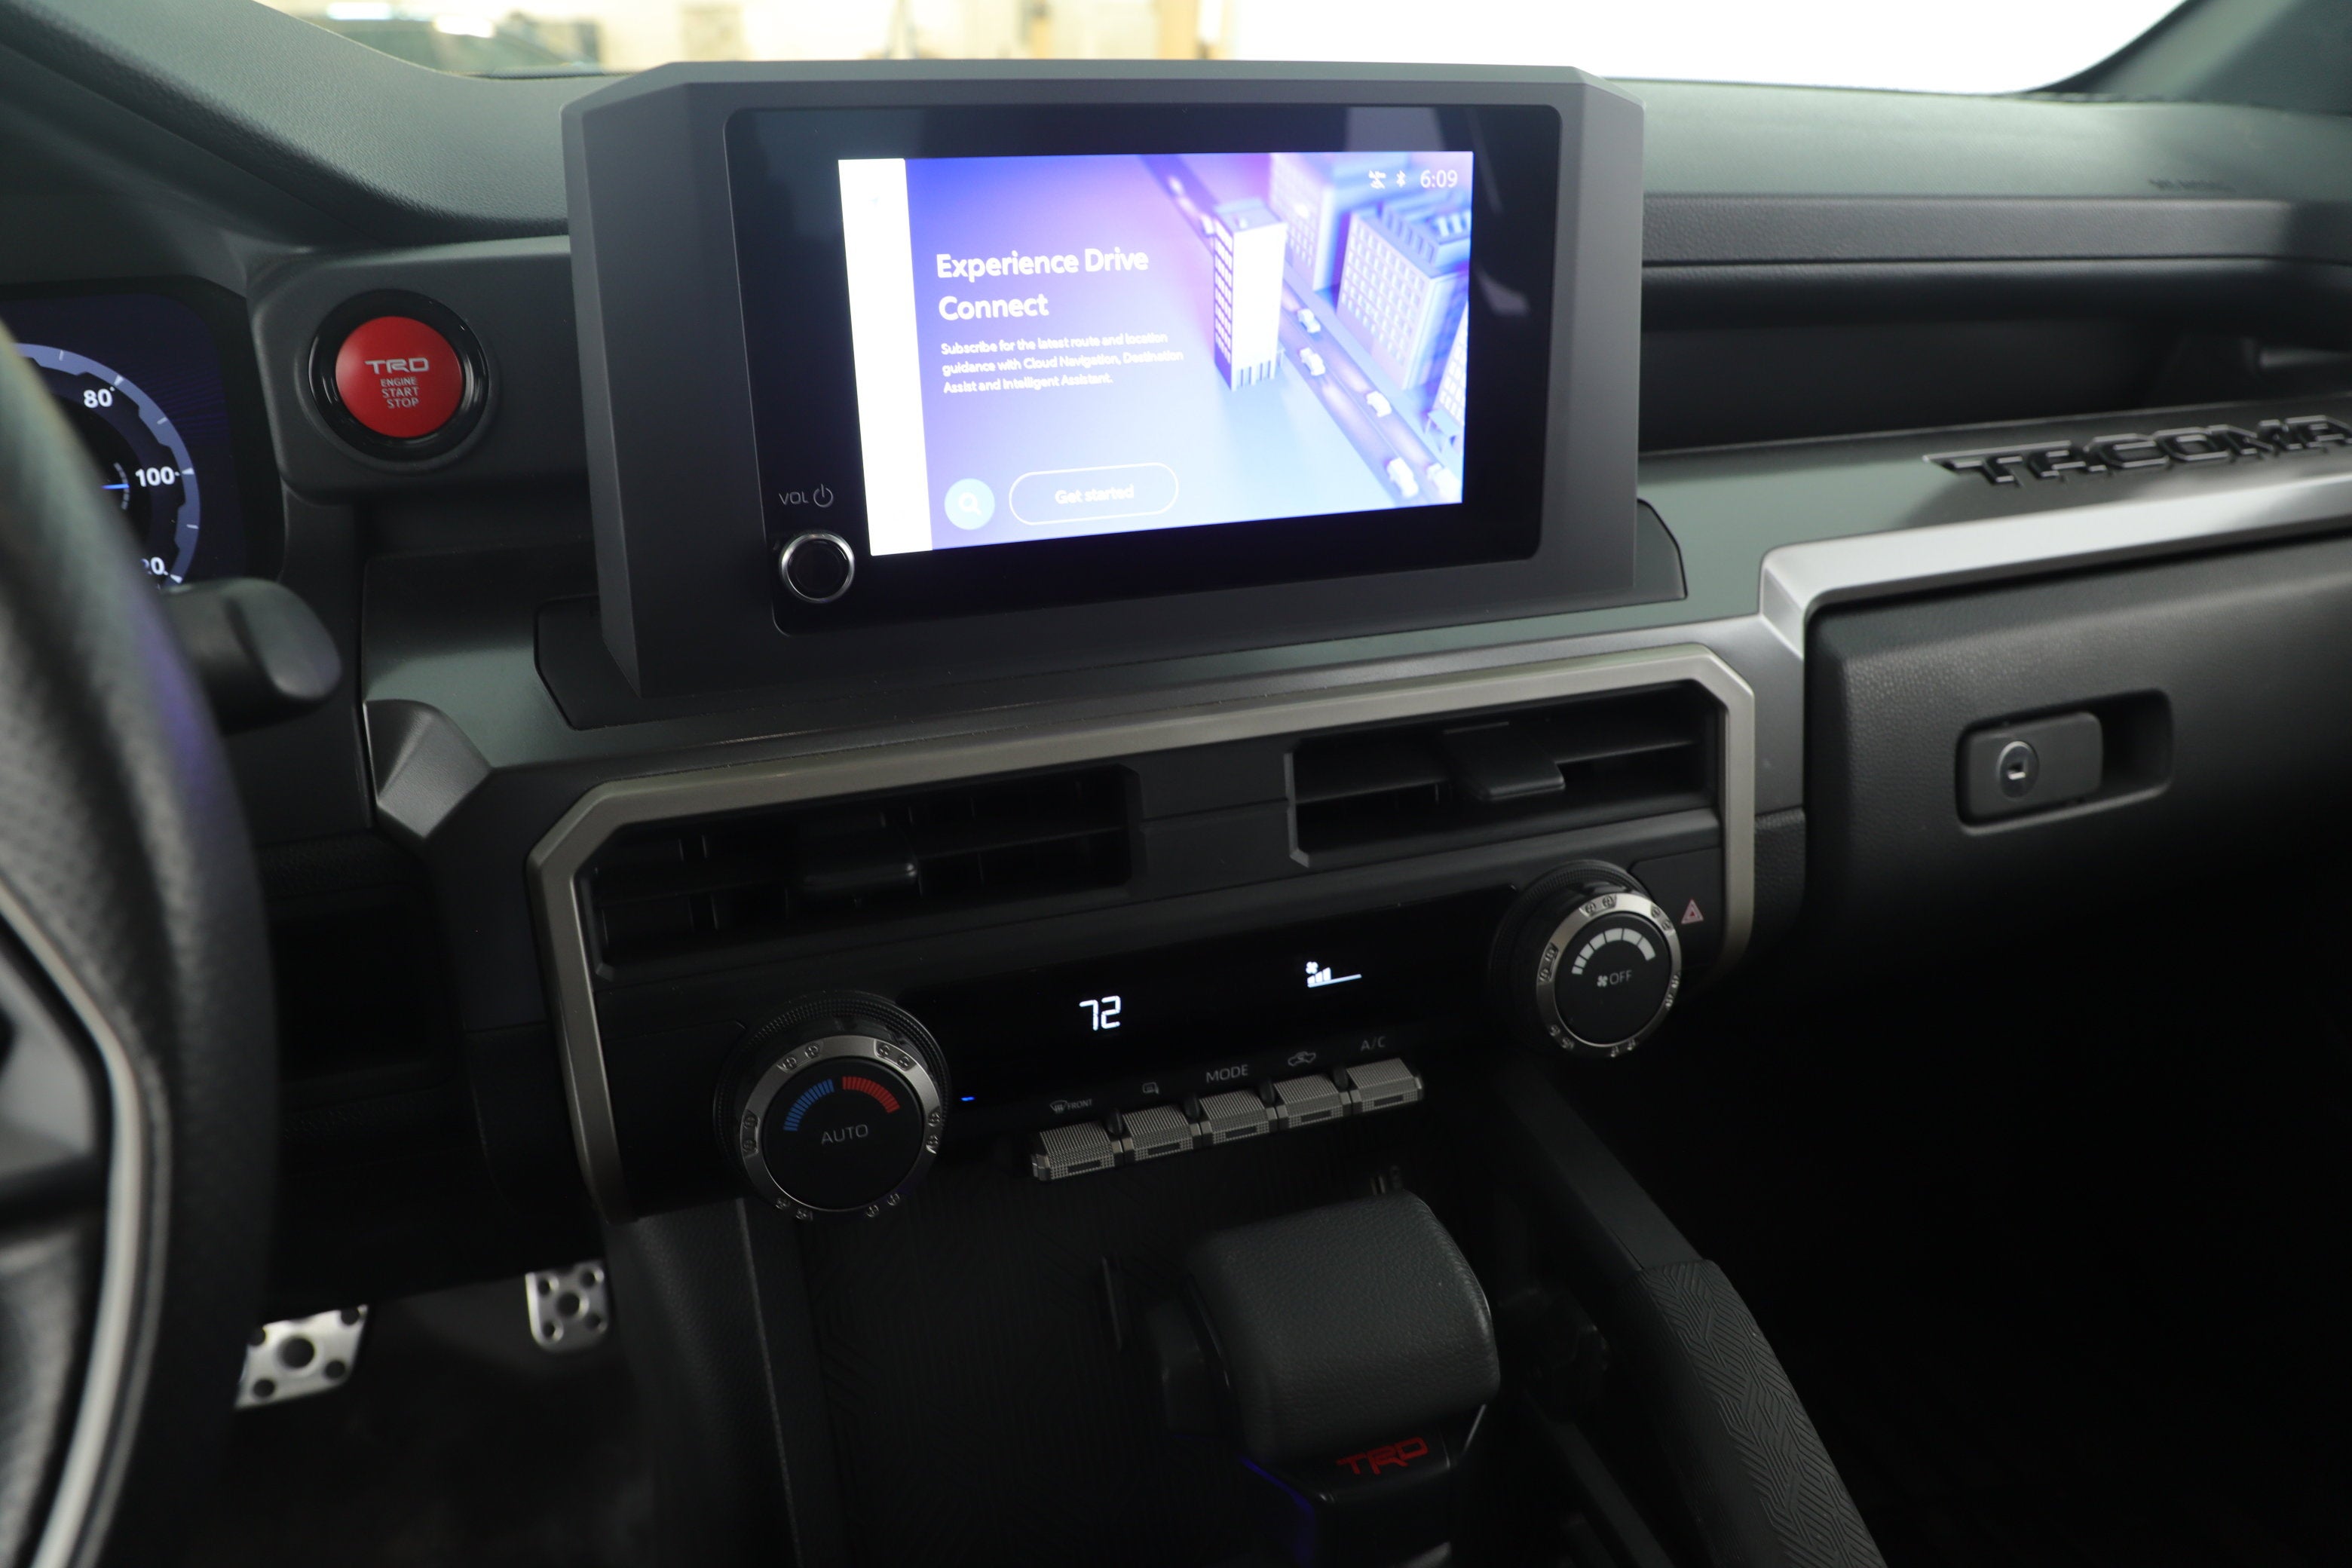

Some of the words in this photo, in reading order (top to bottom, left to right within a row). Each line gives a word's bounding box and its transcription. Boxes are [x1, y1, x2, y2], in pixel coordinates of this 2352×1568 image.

[1420, 169, 1458, 188] 6:09
[936, 250, 1080, 283] Experience
[1084, 247, 1149, 272] Drive
[939, 293, 1049, 320] Connect
[941, 339, 997, 355] Subscribe
[998, 339, 1015, 352] for
[1017, 337, 1037, 351] the
[1037, 335, 1070, 349] latest
[1070, 334, 1101, 348] route
[1101, 333, 1124, 346] and
[1125, 332, 1168, 345] location
[364, 357, 429, 375] TRD
[942, 360, 996, 377] guidance
[997, 357, 1021, 371] with
[1023, 356, 1057, 369] Cloud
[1059, 354, 1121, 368] Navigation,
[1122, 350, 1184, 364] Destination
[380, 376, 418, 387] ENGINE
[943, 380, 978, 394] Assist
[978, 378, 1002, 391] and
[1003, 375, 1060, 390] Intelligent
[1061, 372, 1114, 387] Assistant.
[83, 388, 113, 409] 80
[381, 386, 419, 399] START
[386, 397, 420, 409] STOP
[135, 466, 176, 487] 100
[778, 492, 810, 506] VOL
[1055, 489, 1083, 504] Get
[1084, 482, 1134, 502] started
[1609, 969, 1633, 985] OFF
[1079, 995, 1121, 1031] 72
[1360, 1036, 1386, 1052] A/C
[1206, 1064, 1249, 1083] MODE
[1067, 1098, 1093, 1110] FRONT
[821, 1124, 868, 1144] AUTO
[1335, 1436, 1429, 1475] TRD
